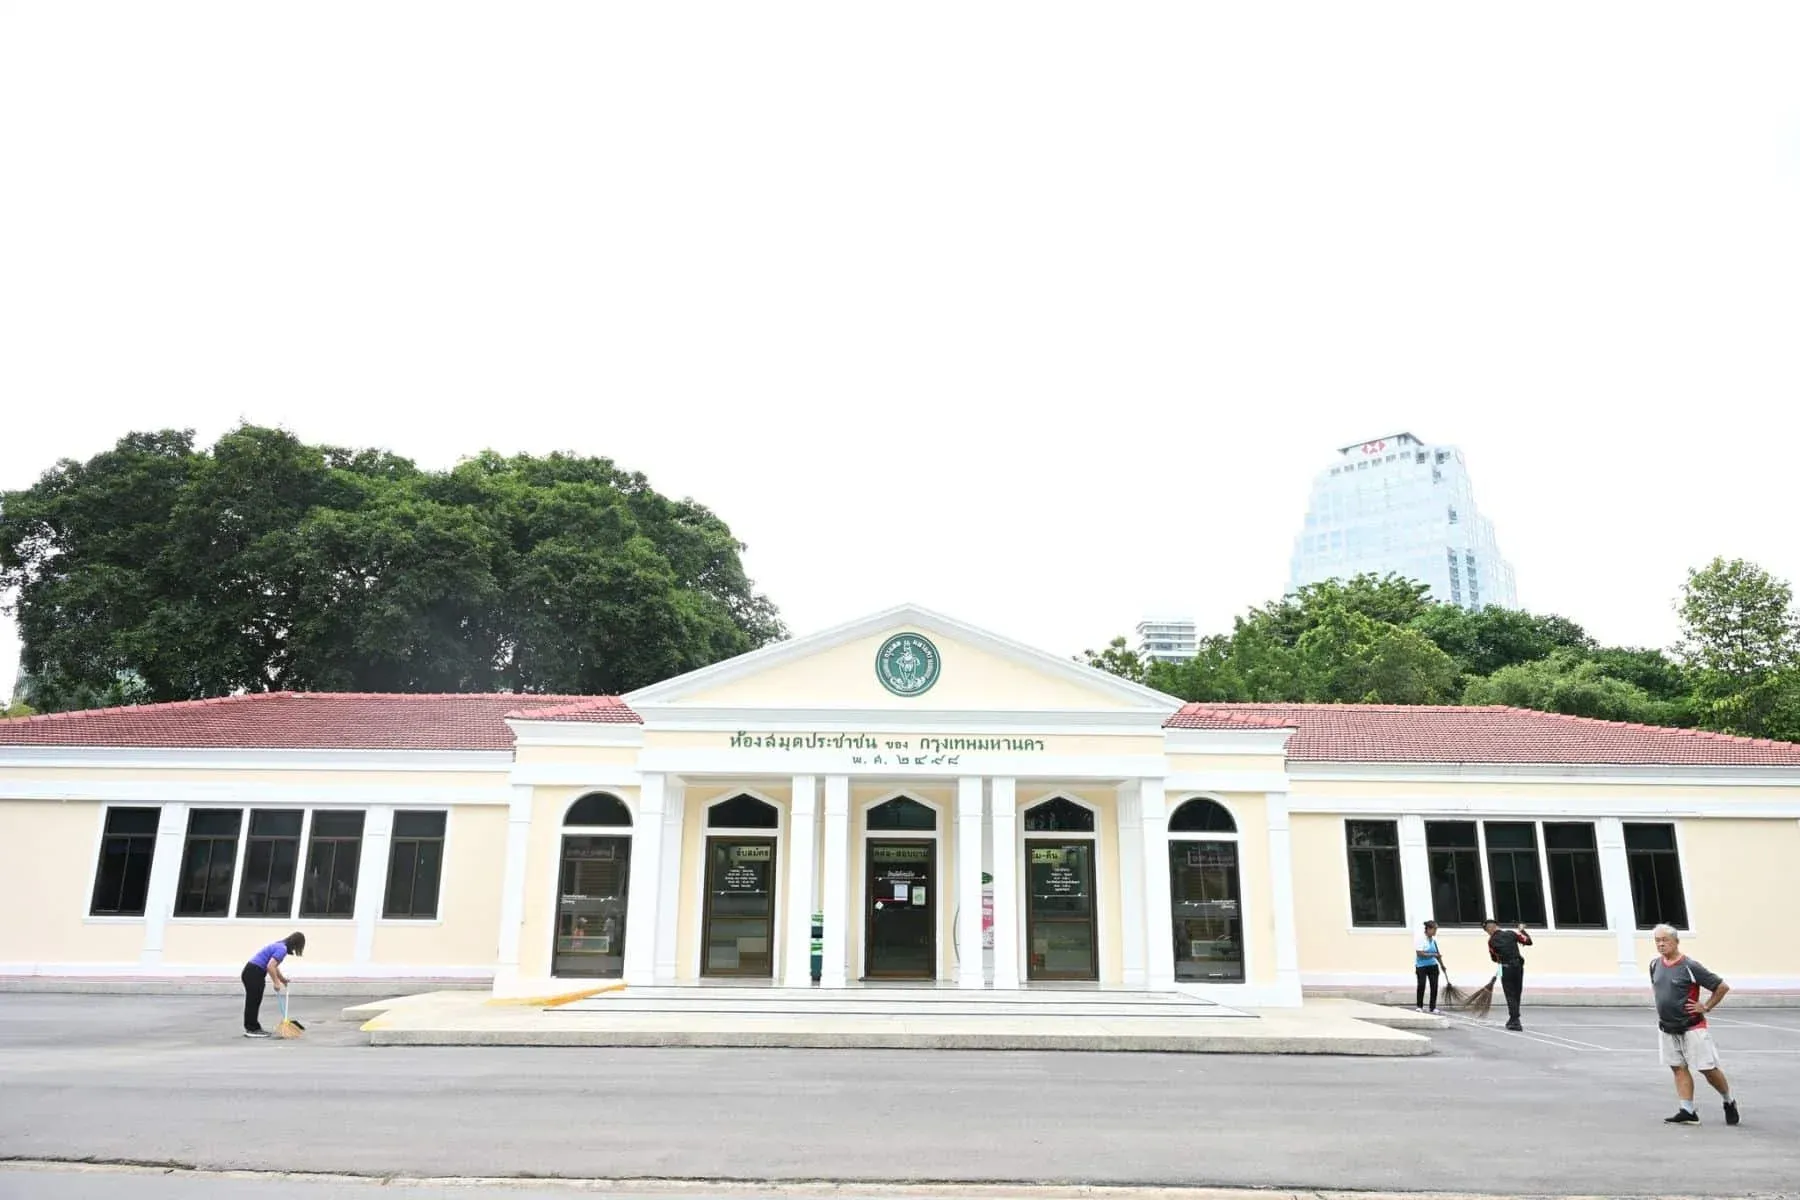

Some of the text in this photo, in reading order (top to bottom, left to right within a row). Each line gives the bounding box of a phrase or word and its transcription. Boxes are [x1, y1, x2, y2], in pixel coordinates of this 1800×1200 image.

[730, 730, 1044, 753] ห้องสมุดประชาชน ของ กรุงเทพมหานคร
